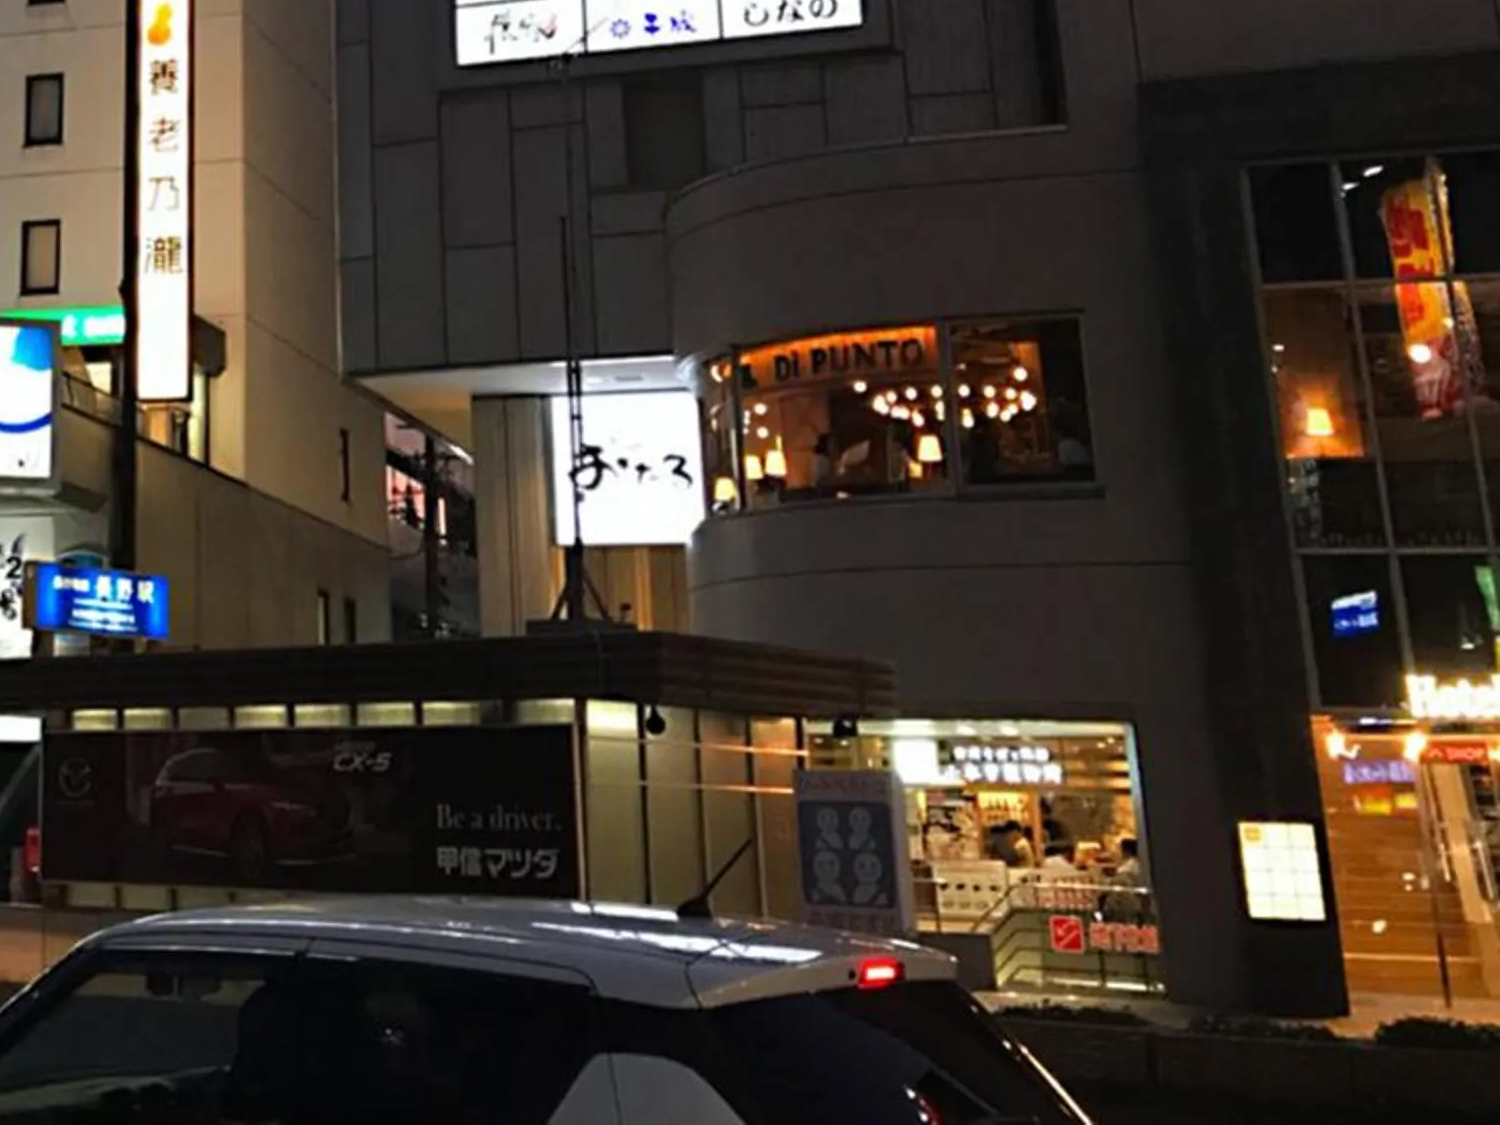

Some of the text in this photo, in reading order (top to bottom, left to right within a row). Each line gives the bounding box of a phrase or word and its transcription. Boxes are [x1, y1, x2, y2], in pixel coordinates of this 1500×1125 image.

[774, 337, 926, 381] DI PUNTO
[333, 751, 393, 773] CX-5
[437, 803, 465, 830] Be
